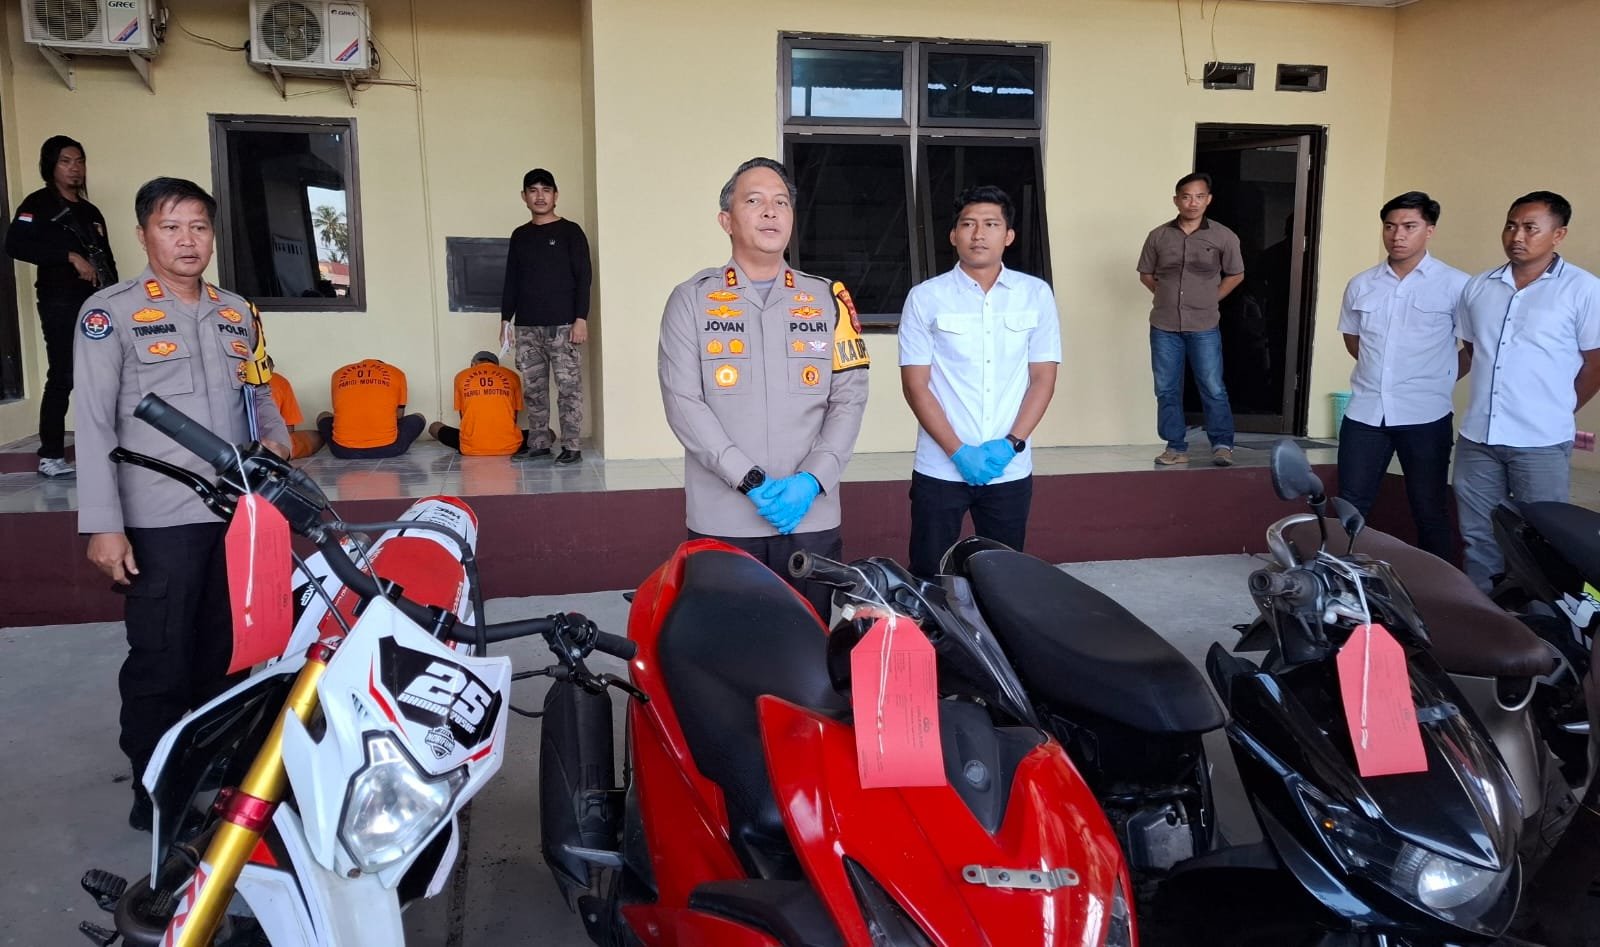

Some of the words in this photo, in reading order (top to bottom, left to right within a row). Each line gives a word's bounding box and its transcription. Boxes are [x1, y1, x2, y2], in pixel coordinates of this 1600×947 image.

[108, 0, 136, 9] GREE
[218, 323, 248, 338] POLRI
[704, 320, 745, 333] JOVAN
[789, 321, 828, 333] POLRI
[836, 340, 857, 363] KA
[479, 377, 494, 387] 05
[402, 661, 492, 726] 25
